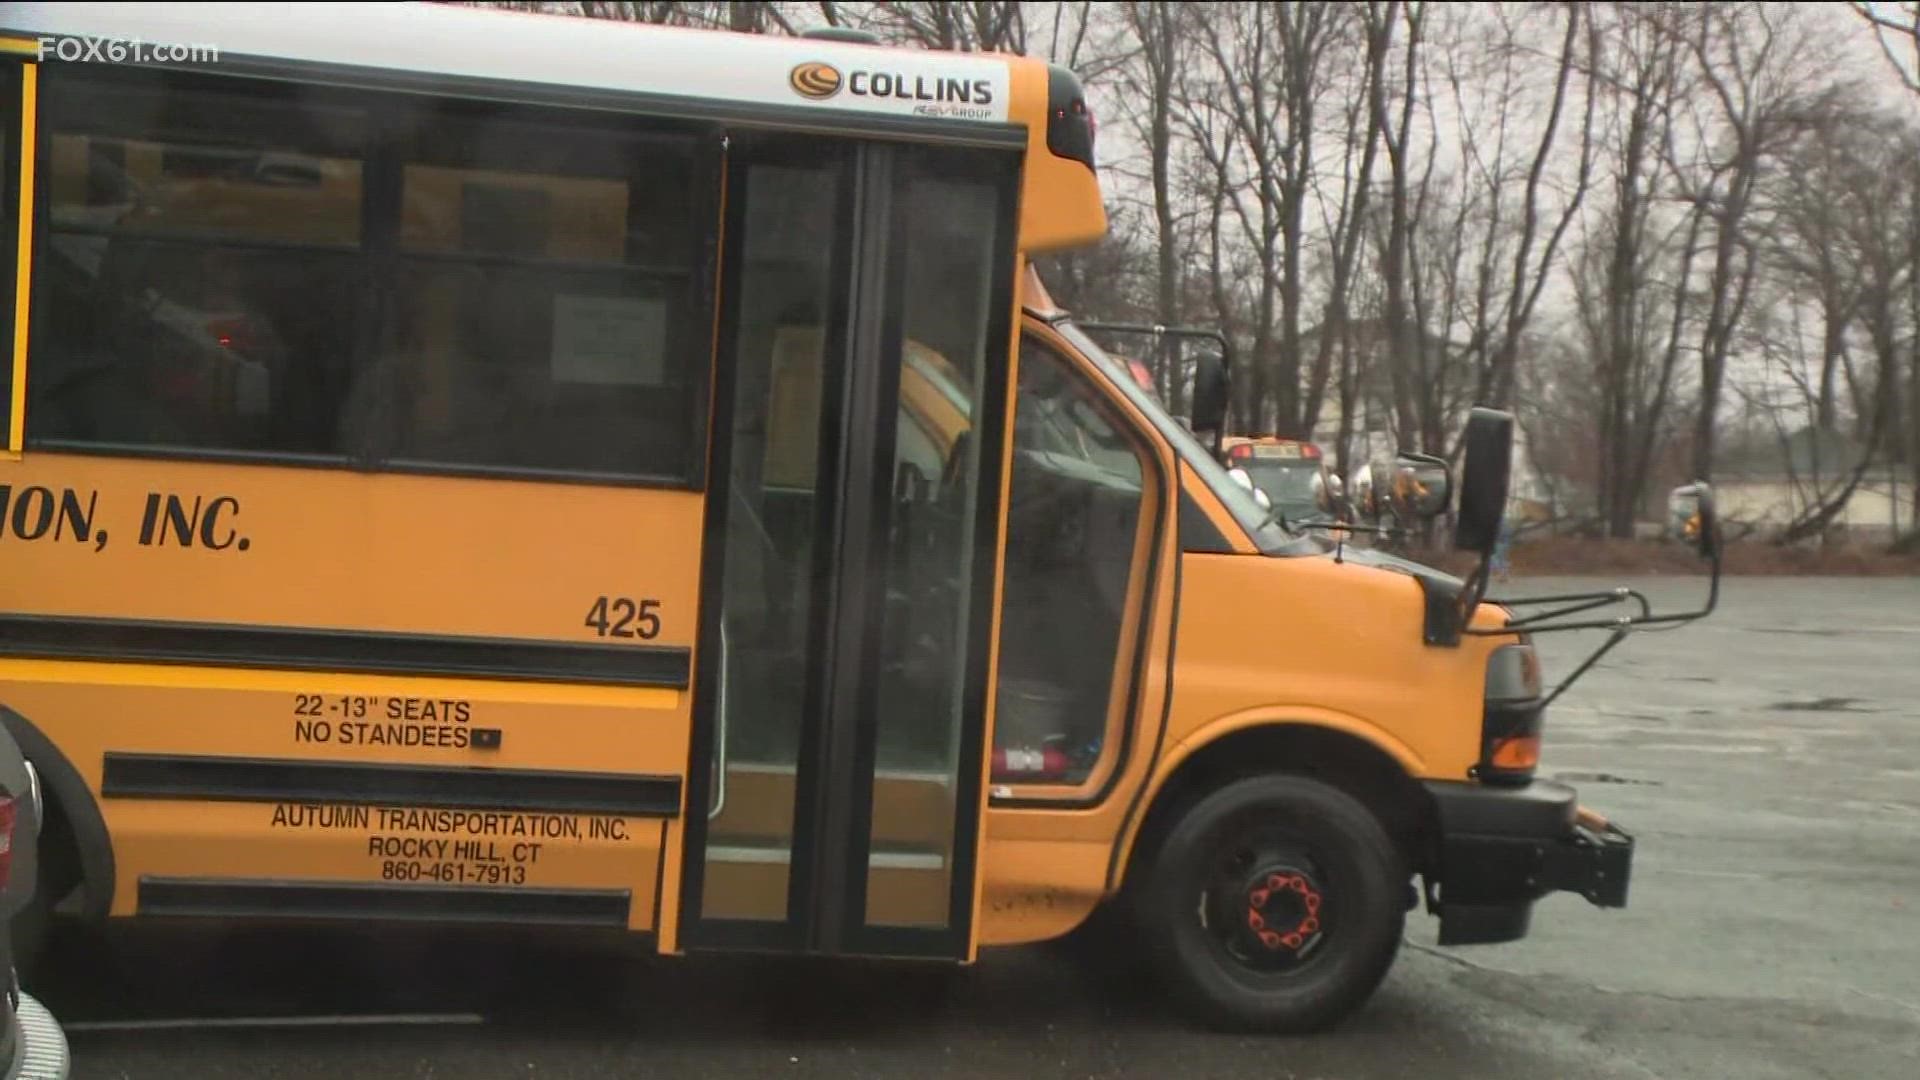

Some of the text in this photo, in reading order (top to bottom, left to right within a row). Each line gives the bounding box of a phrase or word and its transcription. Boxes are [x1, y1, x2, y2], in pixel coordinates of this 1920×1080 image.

[850, 71, 992, 105] COLLINS
[951, 106, 992, 119] GROUP
[138, 492, 250, 551] INC.
[585, 596, 660, 639] 425
[294, 695, 322, 716] 22
[386, 698, 470, 722] SEATS
[295, 721, 468, 748] NO STANDEES
[272, 804, 630, 842] AUTUMN TRANSPORTATION, INC.
[368, 837, 448, 859] ROCKY
[512, 843, 542, 863] CT
[382, 860, 526, 885] 860-461-7913
